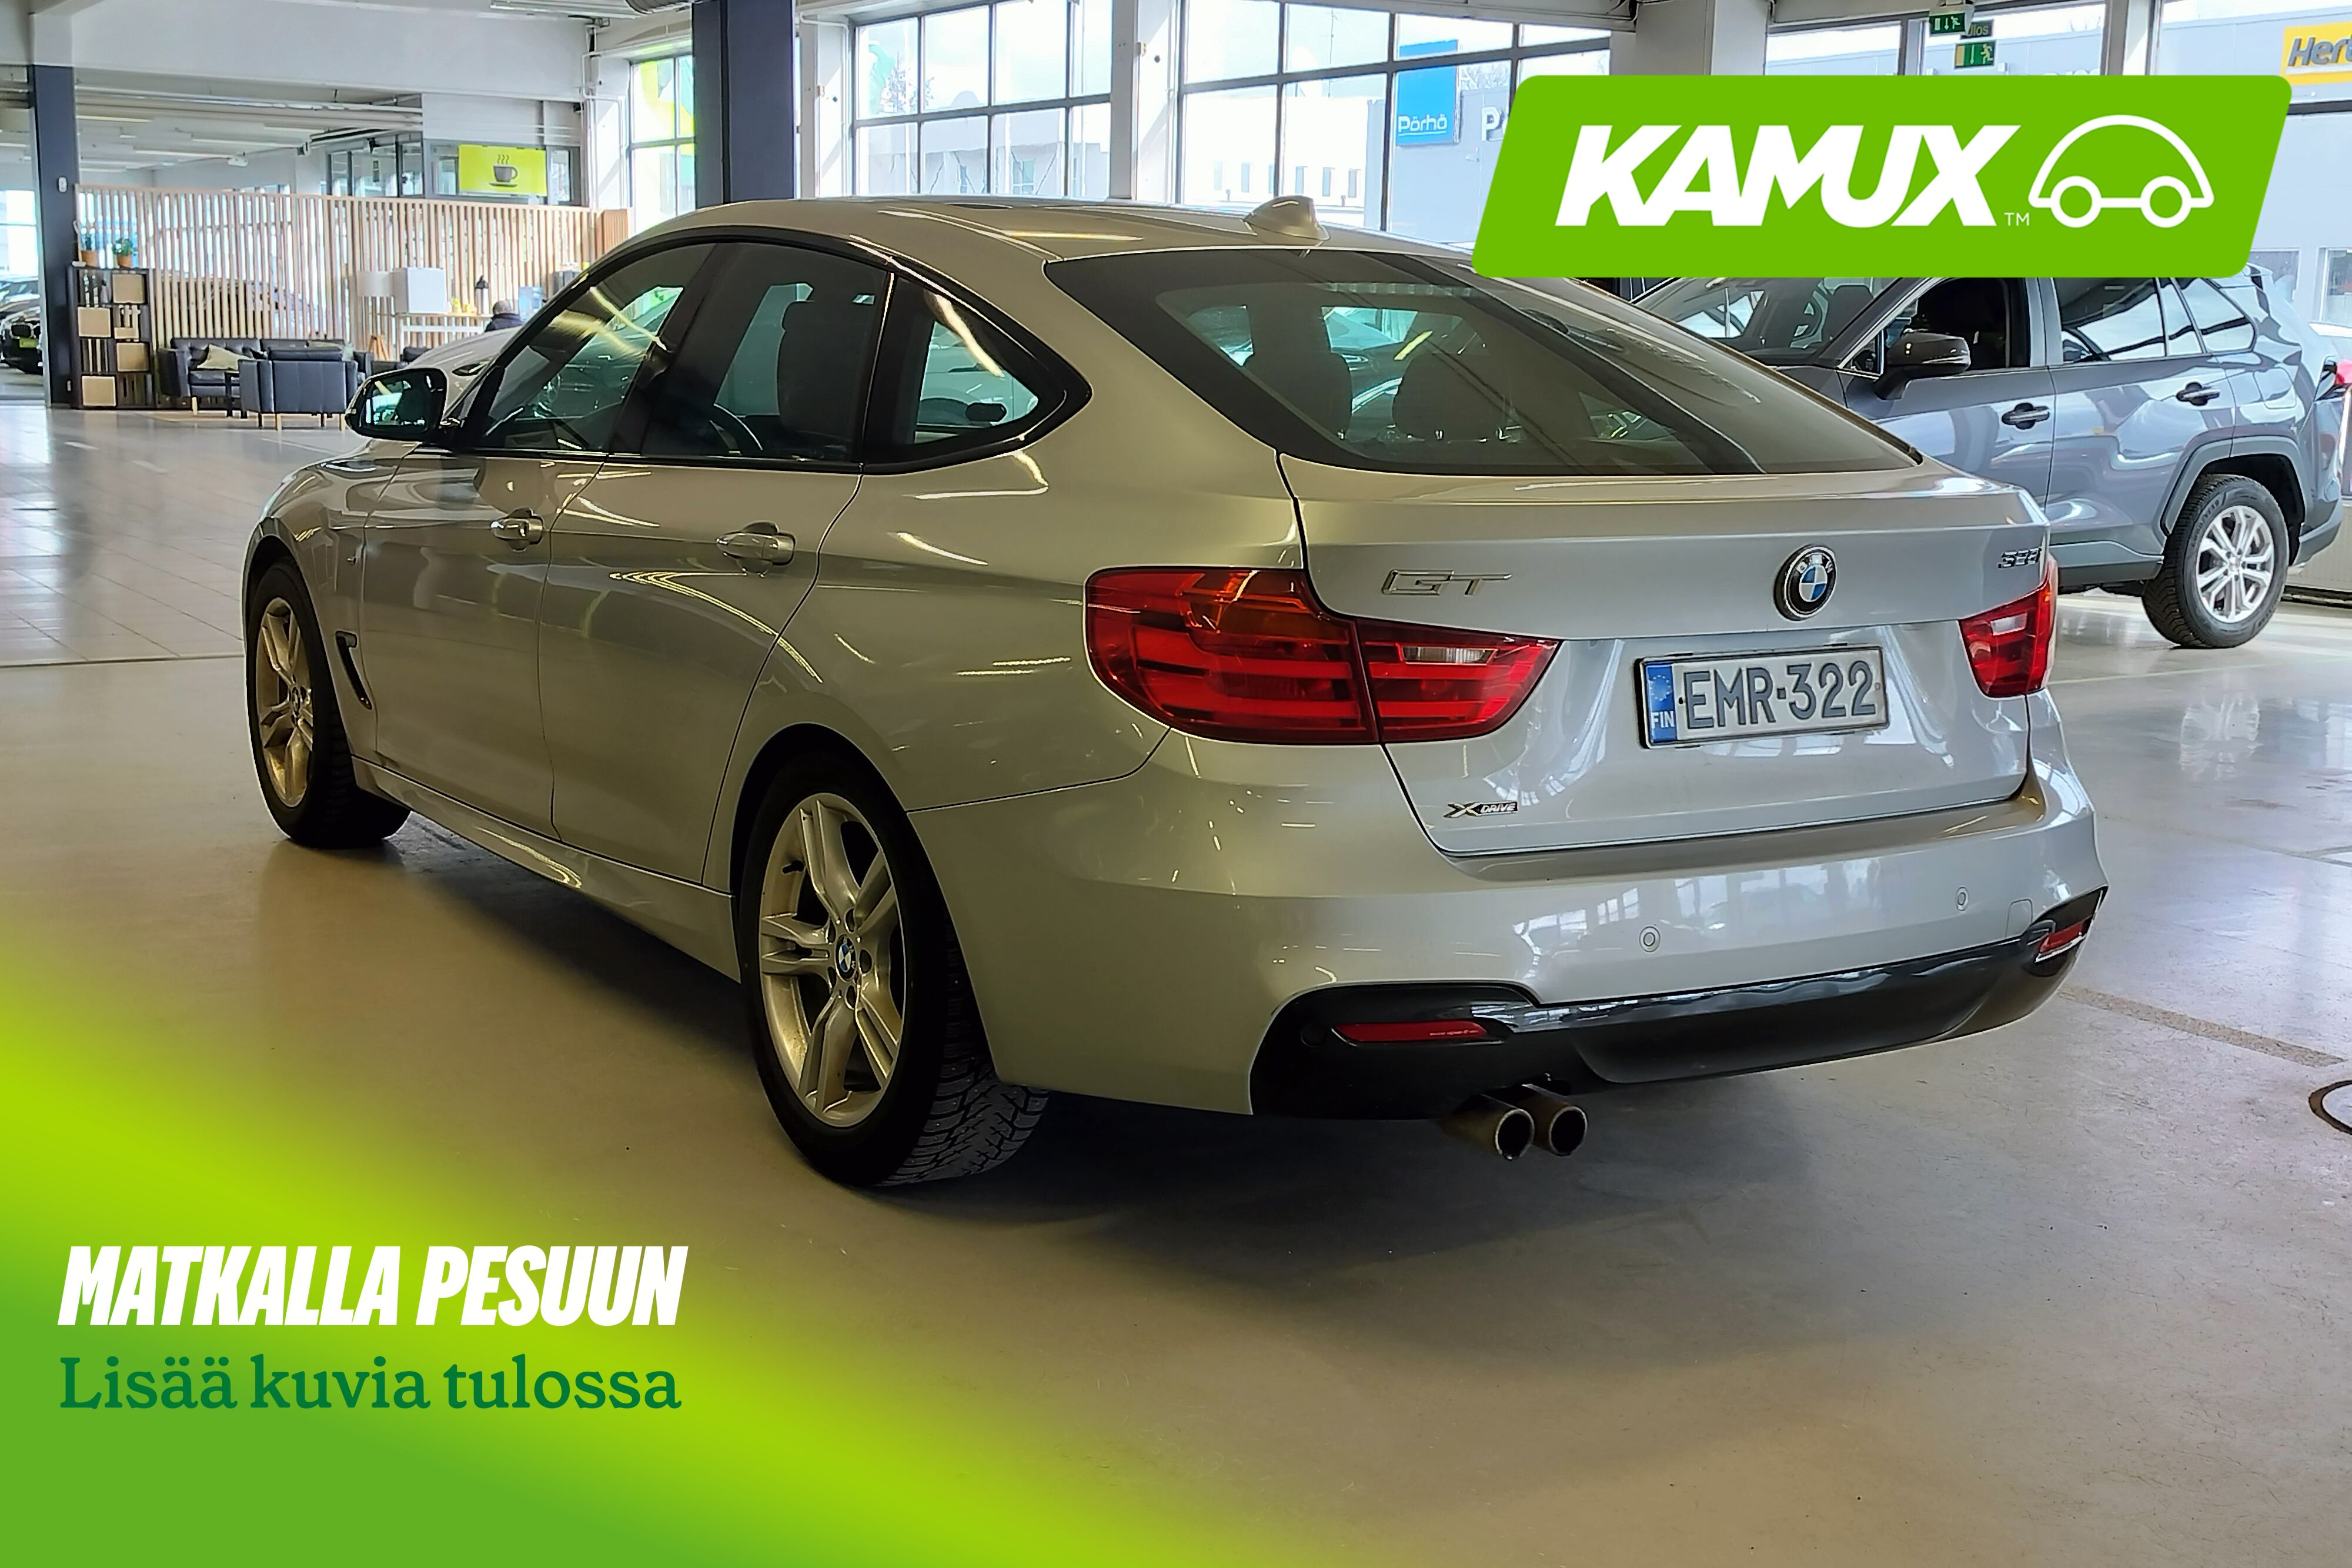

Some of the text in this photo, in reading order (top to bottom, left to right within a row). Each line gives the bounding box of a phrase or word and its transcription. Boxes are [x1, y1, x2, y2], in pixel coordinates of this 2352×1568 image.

[1398, 113, 1447, 132] Pörhö
[1381, 569, 1512, 596] GT
[1683, 660, 1877, 730] EMR-322
[1651, 711, 1675, 730] FIN
